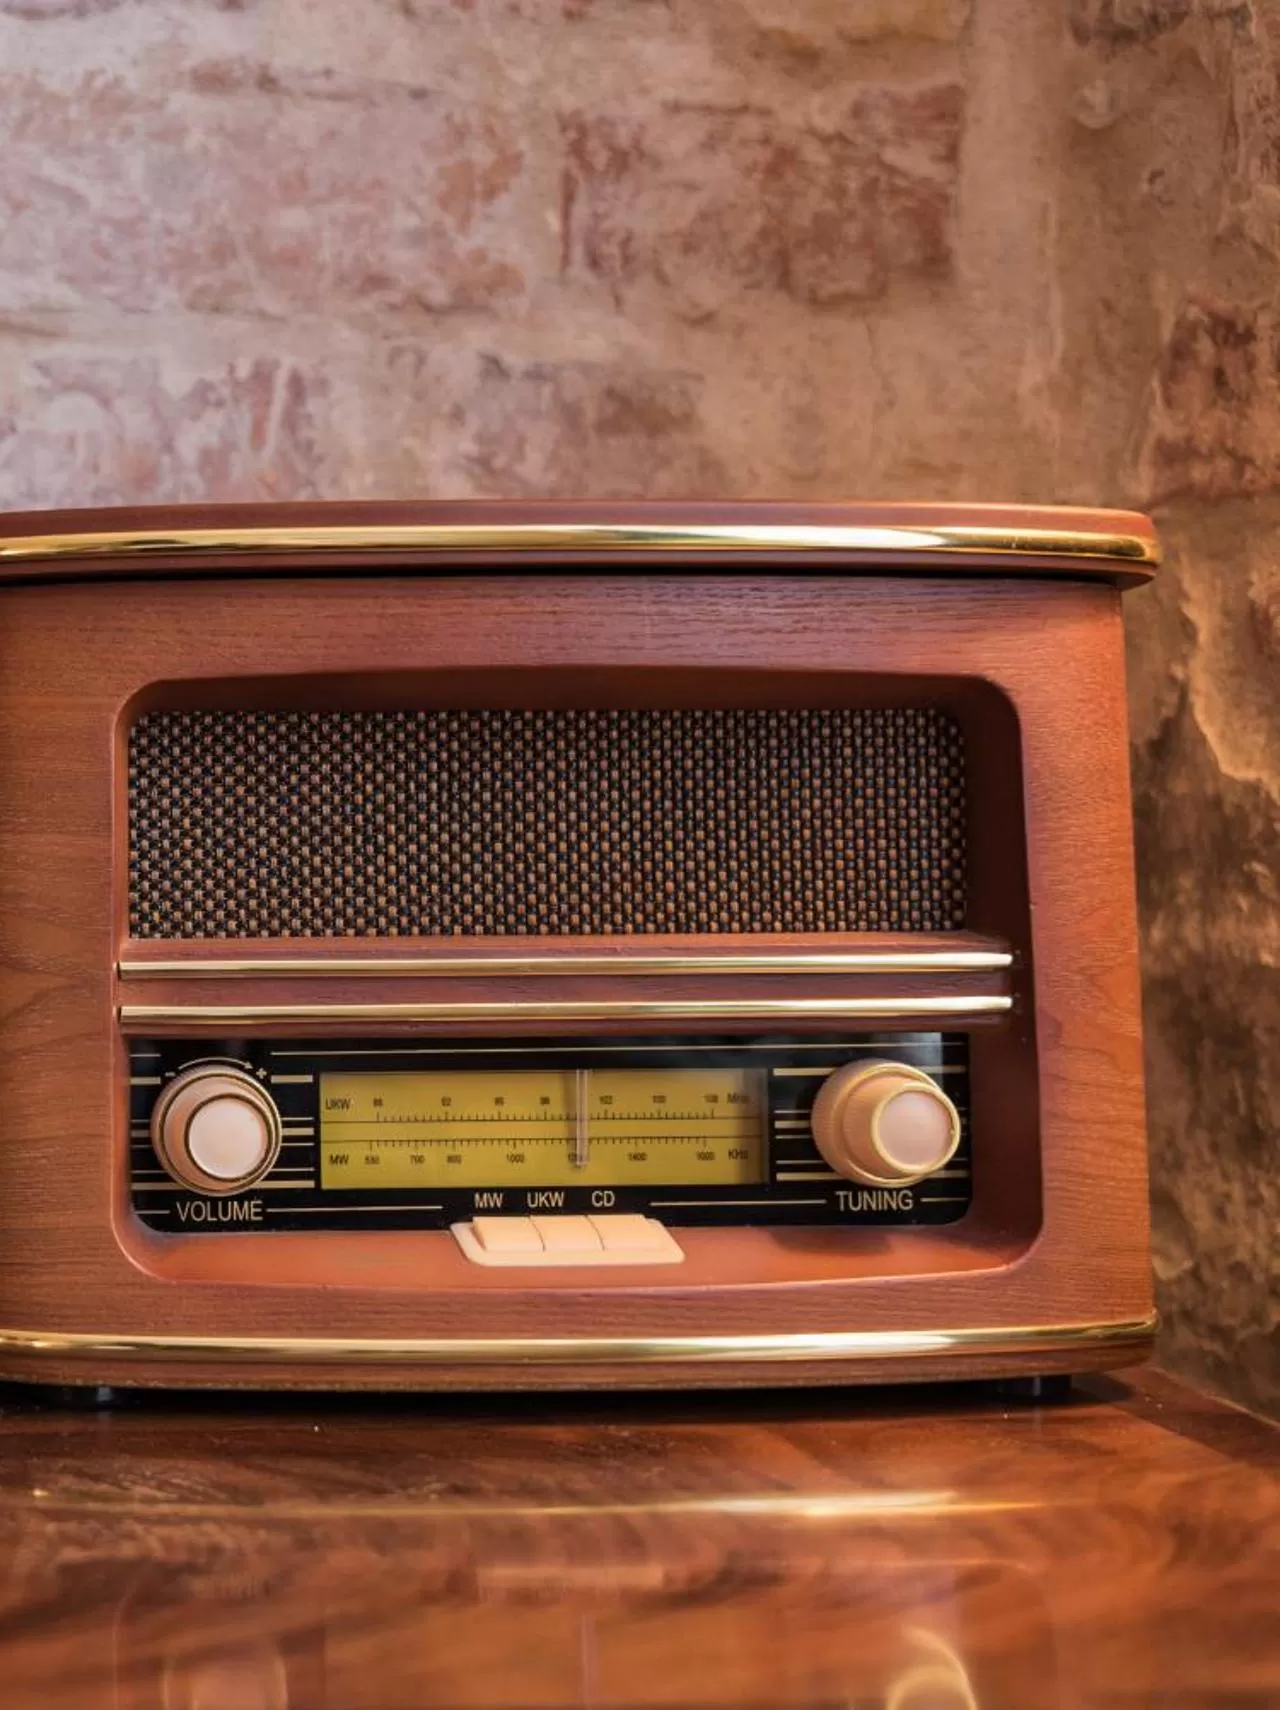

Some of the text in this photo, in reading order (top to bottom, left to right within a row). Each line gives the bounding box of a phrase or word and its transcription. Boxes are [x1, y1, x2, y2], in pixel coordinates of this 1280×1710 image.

[325, 1097, 352, 1111] UKW
[329, 1154, 350, 1166] MW
[474, 1192, 503, 1208] MW
[526, 1191, 564, 1208] UKW
[591, 1190, 615, 1208] CD
[835, 1190, 914, 1212] TUNING
[176, 1200, 264, 1222] VOLUME
